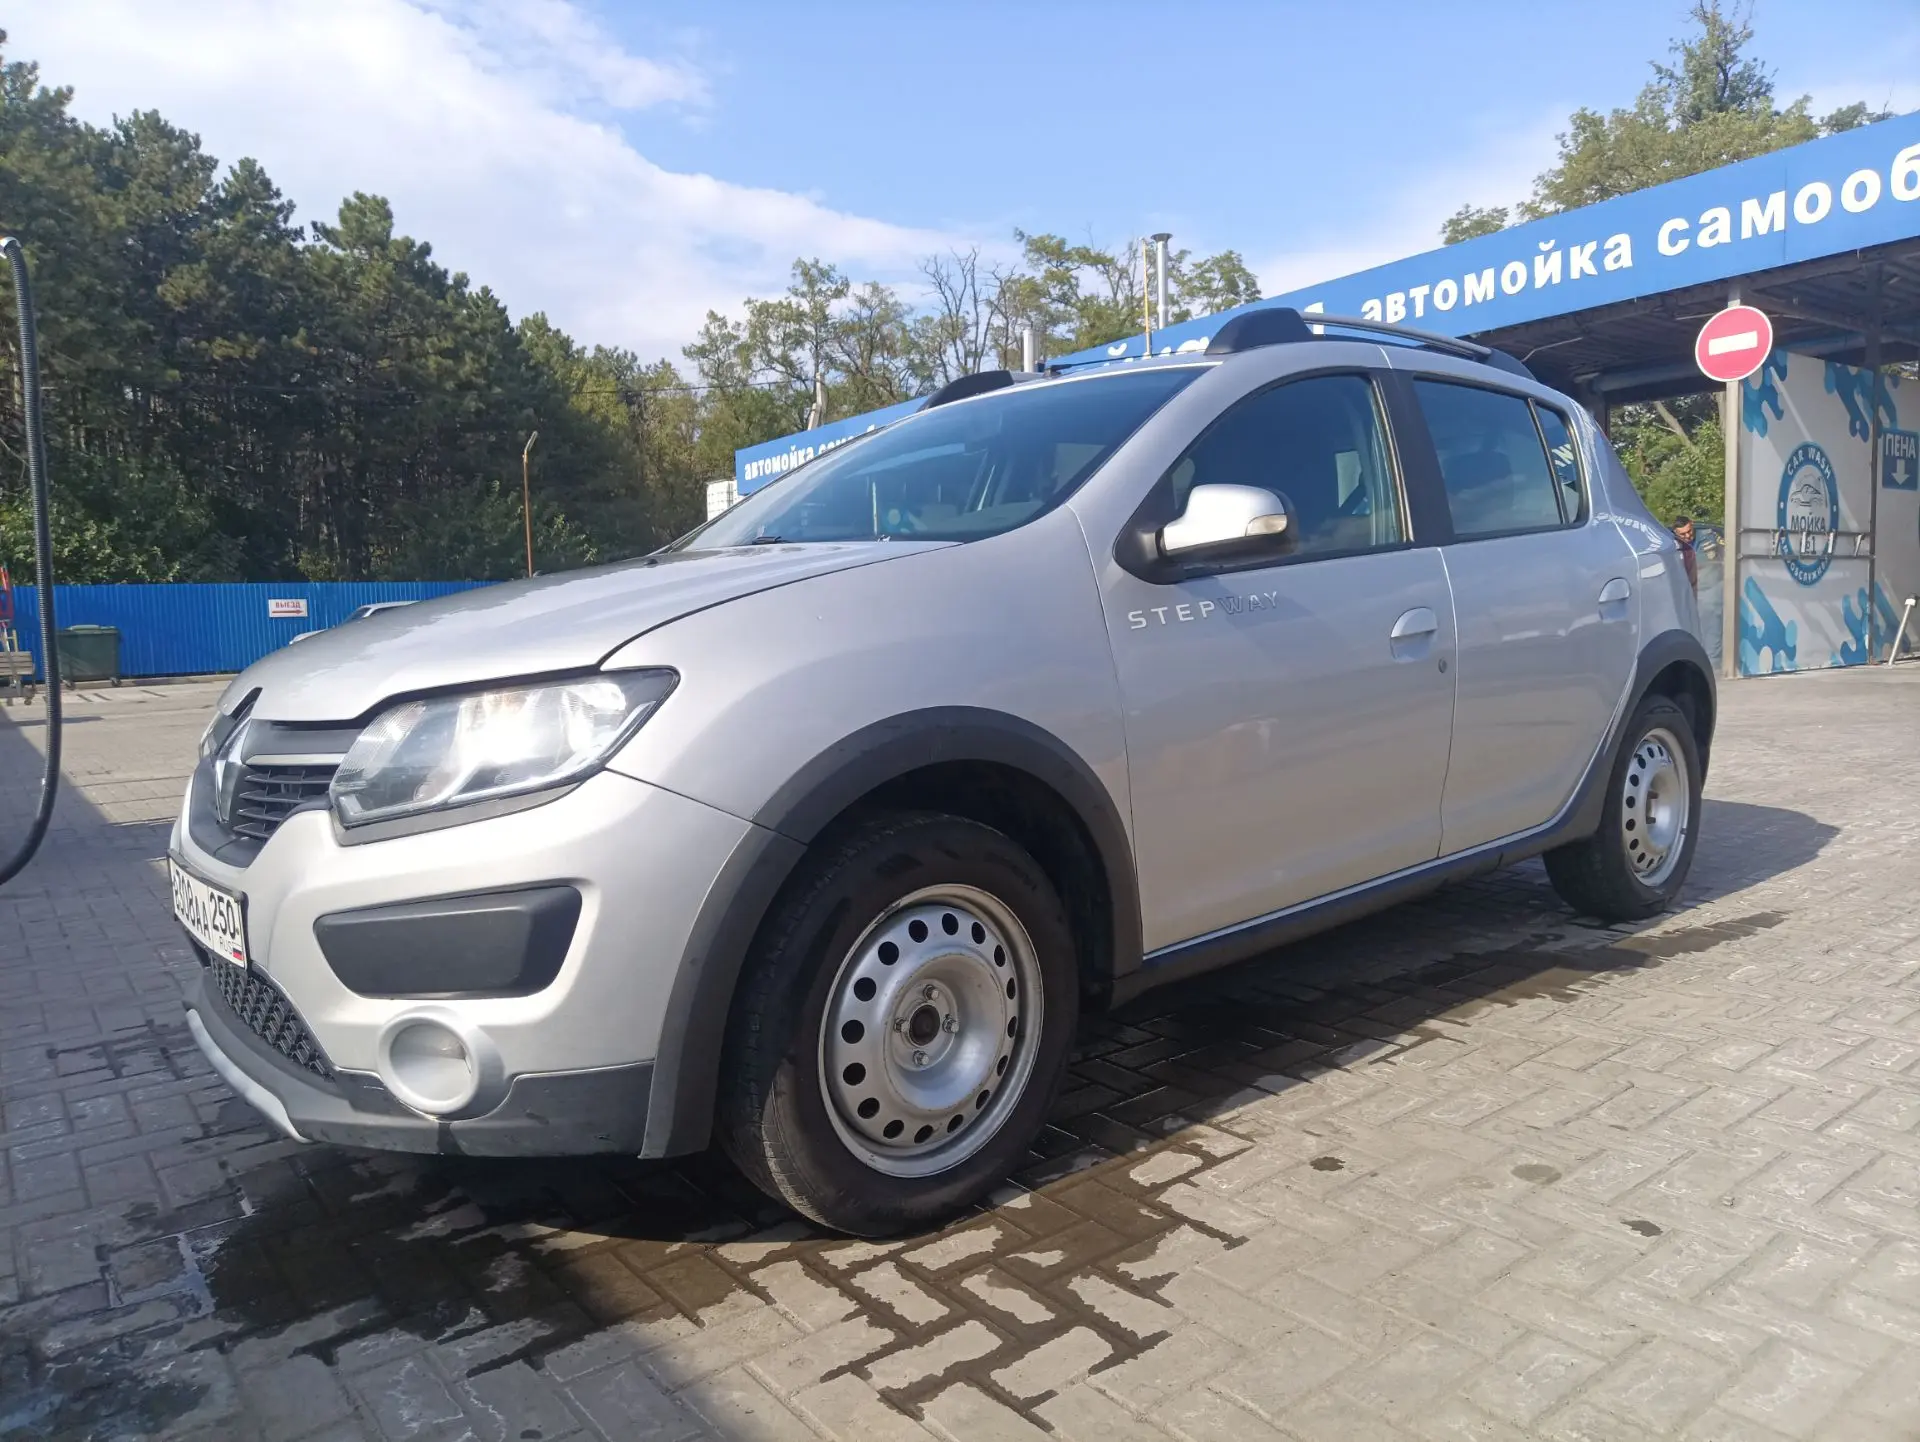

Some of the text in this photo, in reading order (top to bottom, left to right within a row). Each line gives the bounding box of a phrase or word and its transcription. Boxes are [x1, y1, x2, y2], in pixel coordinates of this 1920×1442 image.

[1361, 143, 1920, 324] автомойка самооб
[744, 444, 814, 480] автомойка
[1787, 447, 1831, 479] CAR WASH
[1885, 433, 1916, 460] ПЕНА
[1790, 512, 1827, 533] МОЙКА
[275, 601, 301, 609] ВЫЕЗД
[1128, 591, 1278, 630] STEPWAY
[210, 892, 236, 940] 250
